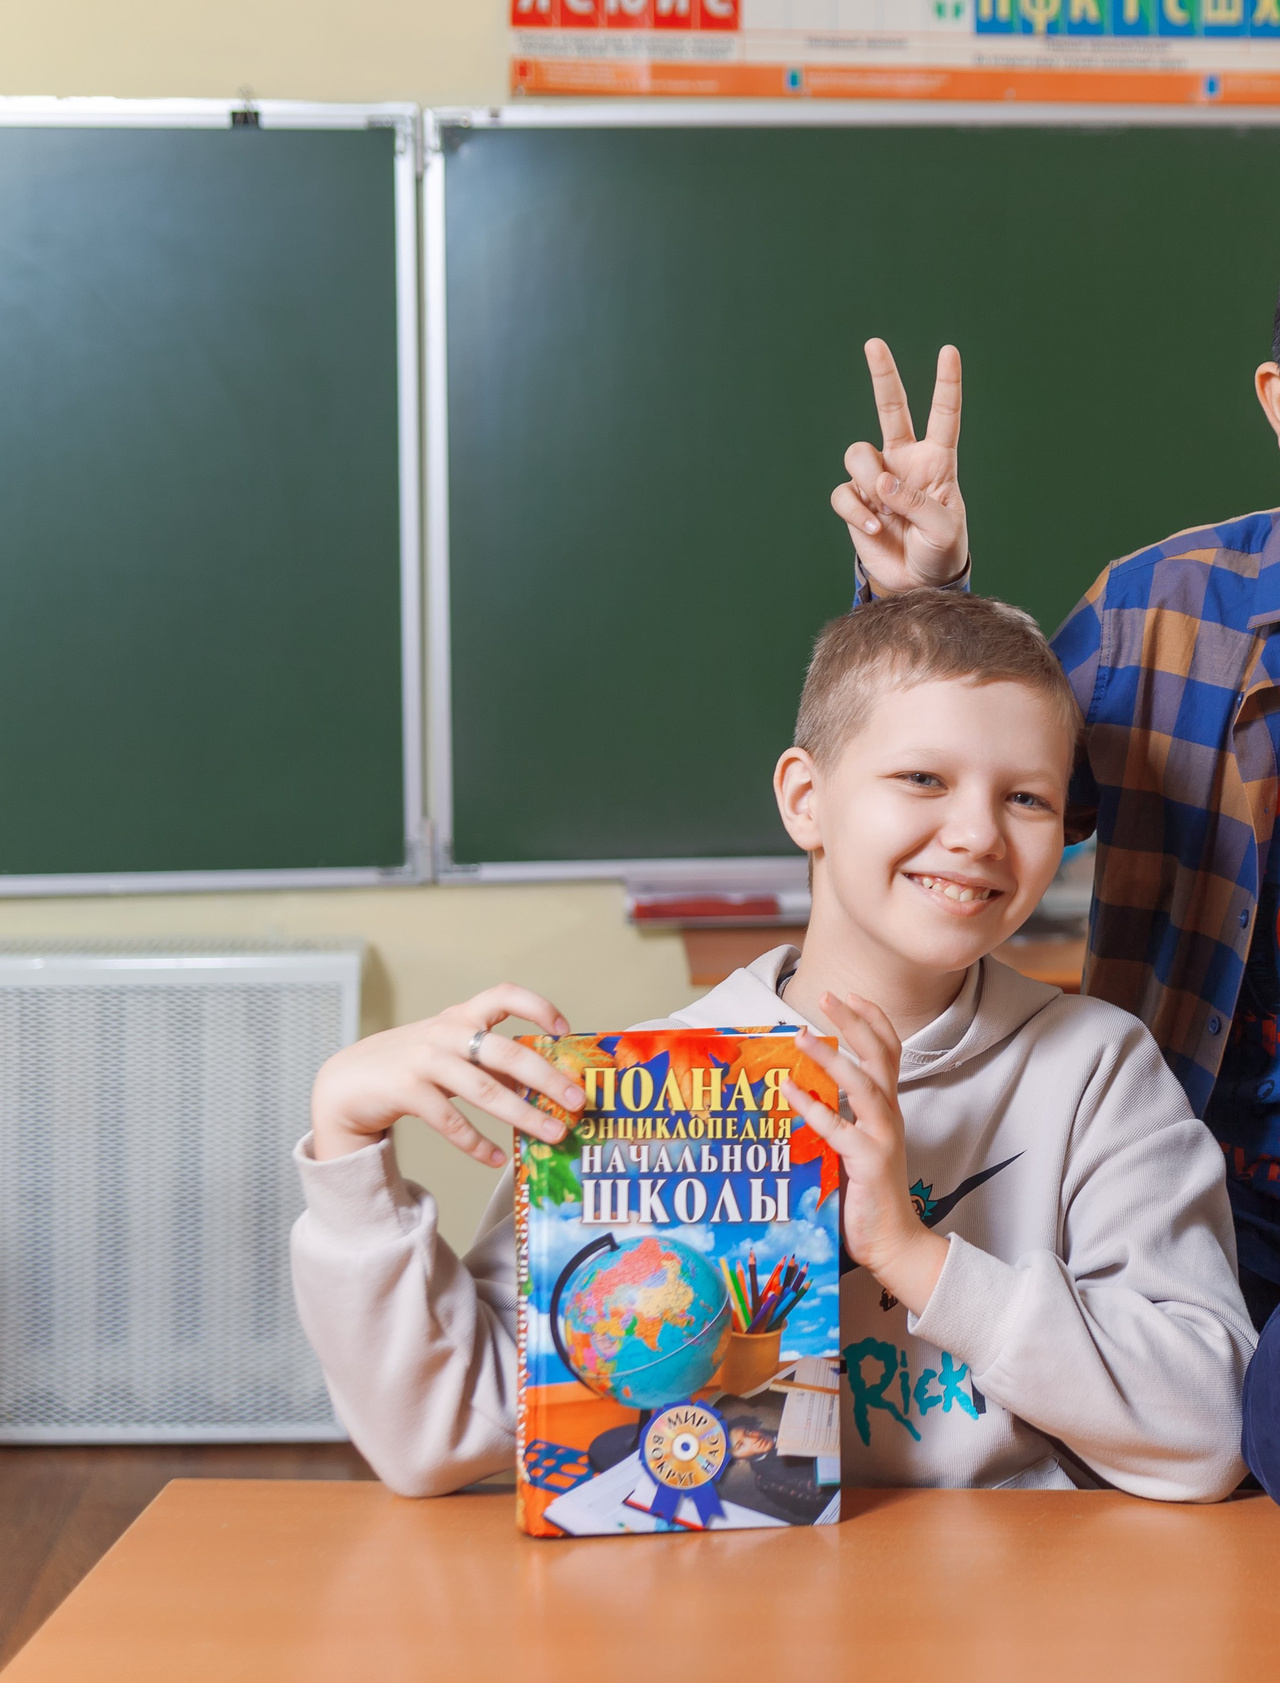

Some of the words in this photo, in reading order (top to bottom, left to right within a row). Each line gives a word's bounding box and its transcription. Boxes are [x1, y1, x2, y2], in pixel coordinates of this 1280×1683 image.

[583, 1067, 791, 1112] ПОЛНАЯ
[581, 1117, 792, 1143] ЭНЦИКЛОПЕДИЯ
[581, 1139, 791, 1173] НАЧАЛЬНОЙ
[581, 1178, 791, 1225] ШКОЛЫ
[840, 1337, 979, 1447] Rick
[667, 1411, 708, 1429] МИР
[651, 1434, 695, 1485] ВОКРУГ
[701, 1435, 720, 1474] НАС
